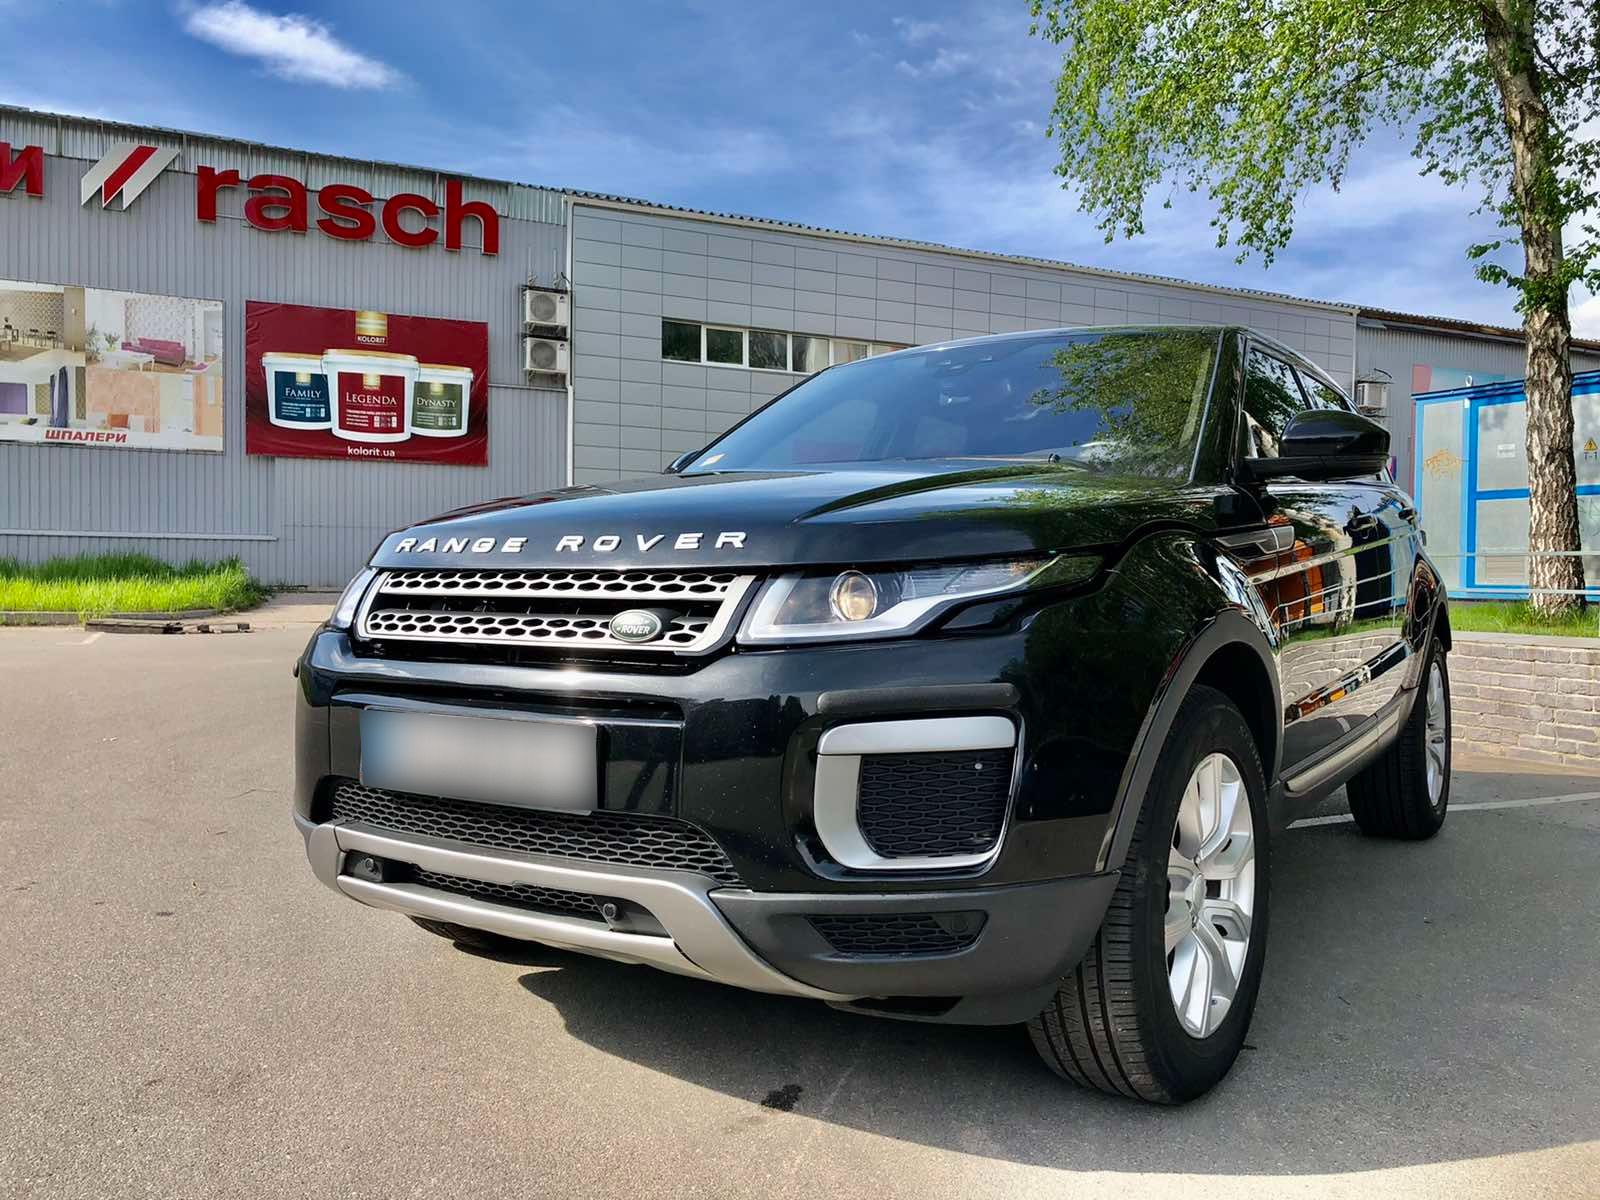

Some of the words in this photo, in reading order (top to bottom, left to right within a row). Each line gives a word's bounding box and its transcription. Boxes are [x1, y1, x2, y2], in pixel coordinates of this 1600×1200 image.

[197, 165, 499, 254] rasch
[357, 335, 385, 344] KOLORIT
[45, 429, 127, 443] ШПАЛЕРИ
[347, 445, 396, 458] kolorit.ua
[395, 537, 527, 553] RANGE
[556, 532, 746, 552] ROVER
[621, 624, 650, 634] ROVER
